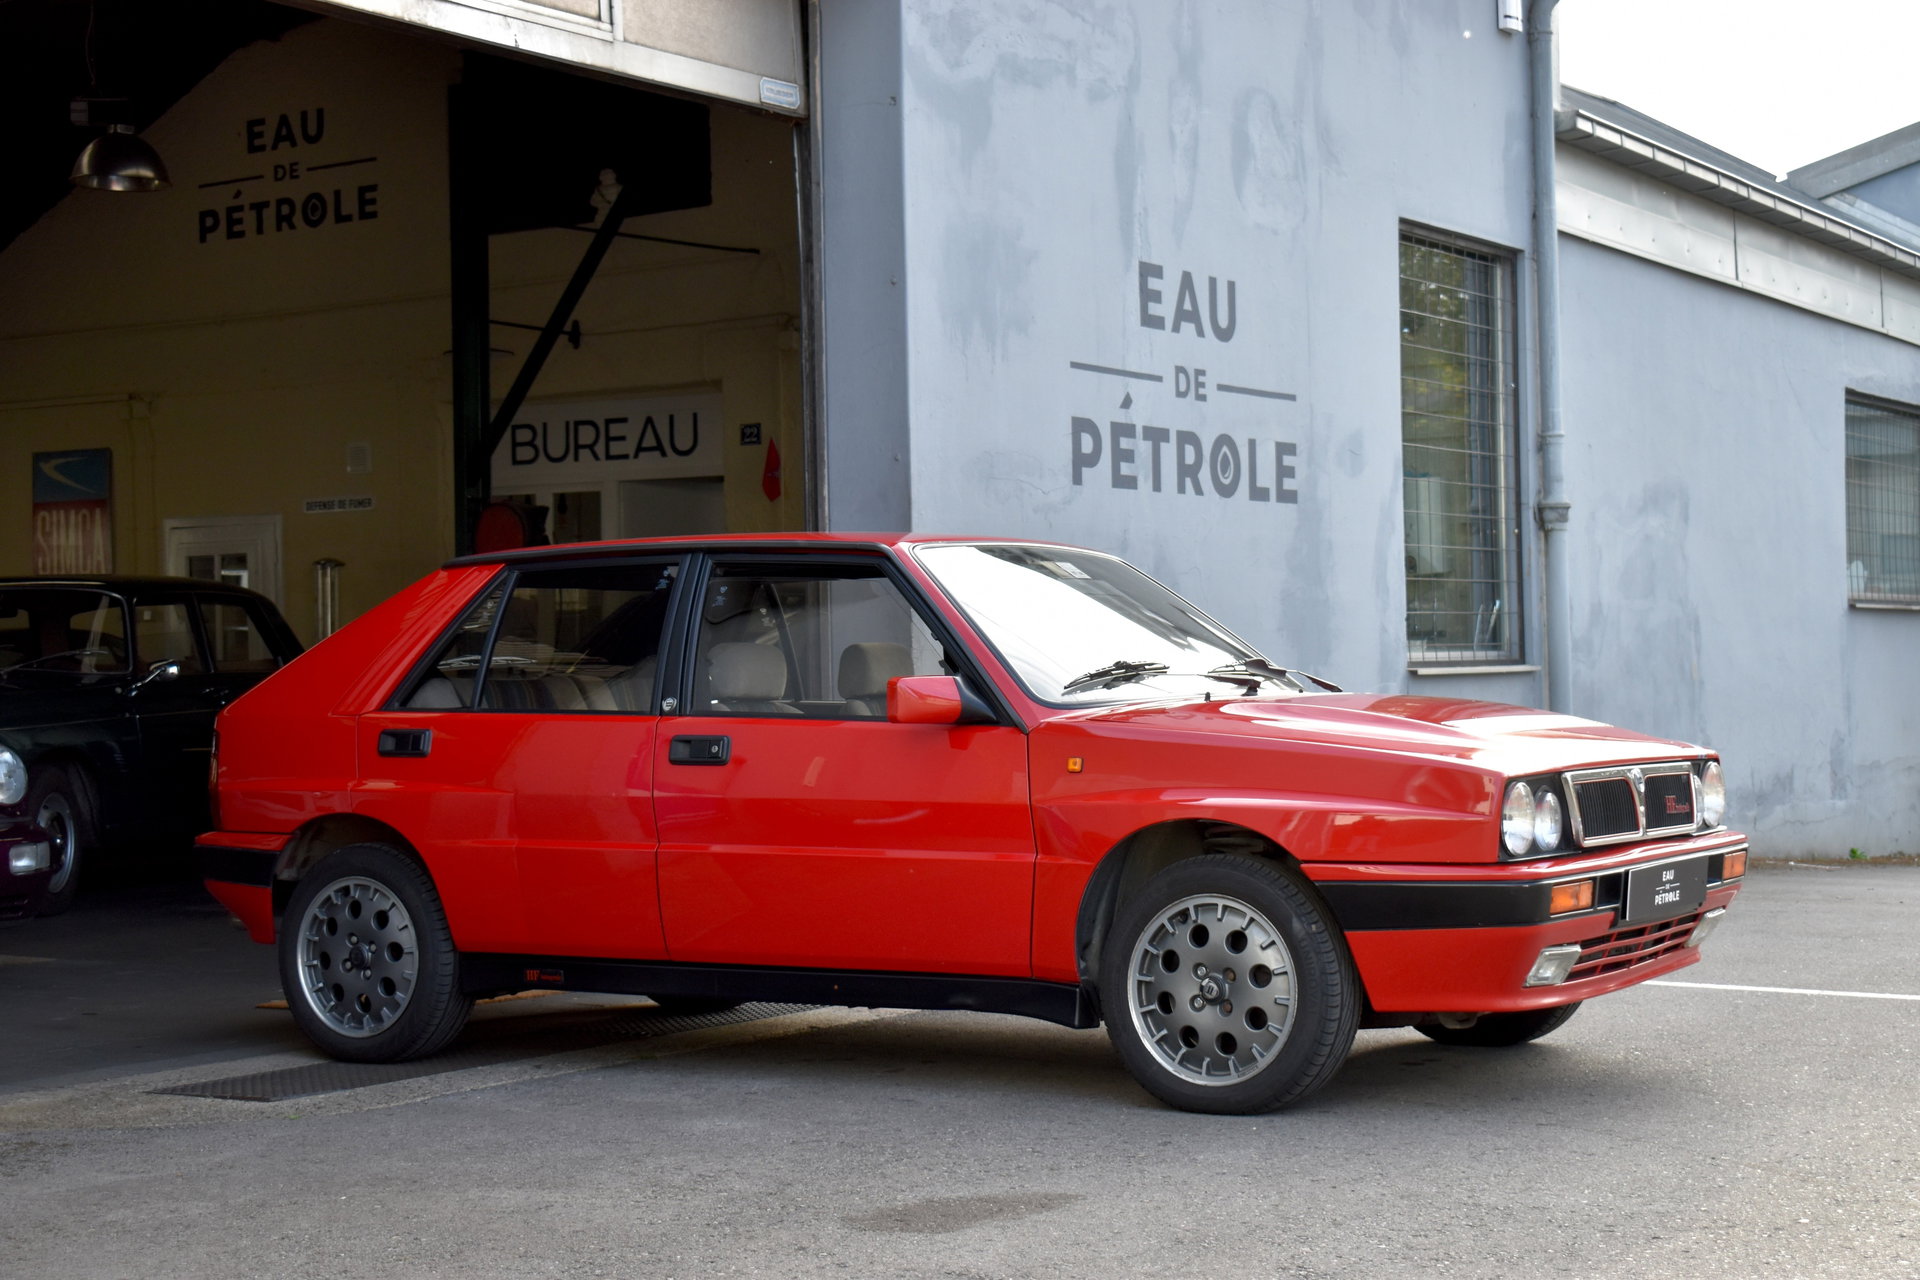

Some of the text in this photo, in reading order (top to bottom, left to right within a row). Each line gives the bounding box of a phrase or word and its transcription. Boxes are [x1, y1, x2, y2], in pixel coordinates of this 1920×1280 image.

[246, 107, 325, 154] EAU
[273, 162, 300, 182] DE
[199, 184, 379, 244] PÉTROLE
[1138, 260, 1237, 343] EAU
[1174, 365, 1208, 402] DE
[511, 412, 699, 466] BUREAU
[743, 426, 758, 442] 22
[1071, 391, 1298, 504] PÉTROLE
[37, 507, 106, 574] SIMCA
[1654, 890, 1680, 906] PÉTROLE
[1662, 869, 1675, 882] EAU
